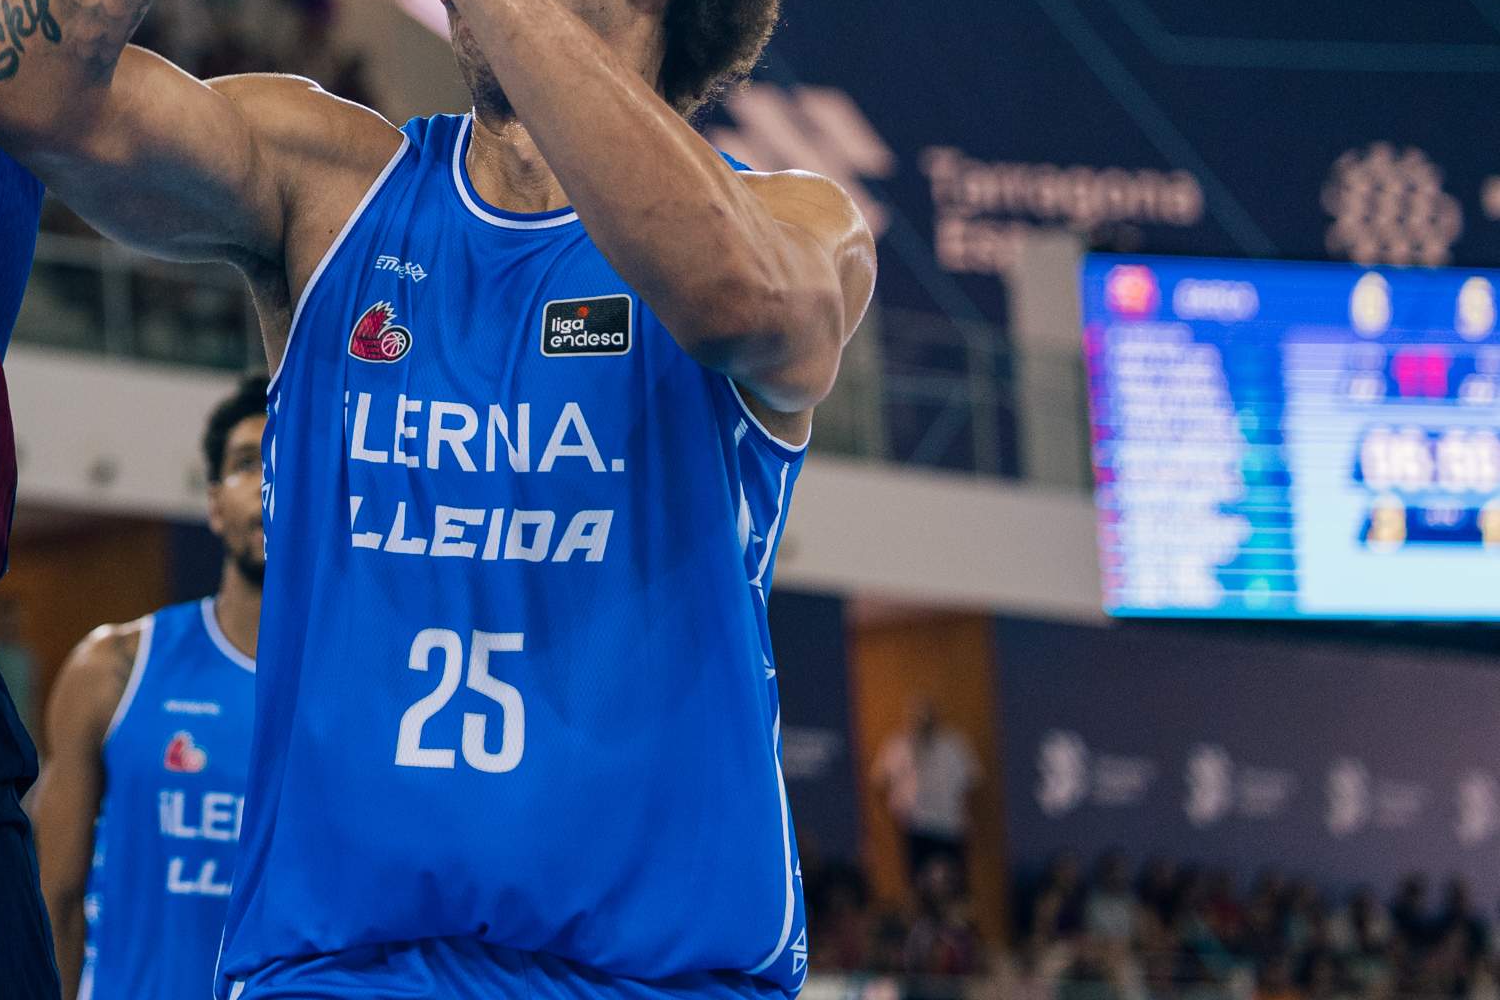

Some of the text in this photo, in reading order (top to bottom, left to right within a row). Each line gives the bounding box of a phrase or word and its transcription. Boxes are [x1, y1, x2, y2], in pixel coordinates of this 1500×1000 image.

[550, 330, 624, 348] endesa
[551, 317, 584, 334] liga
[350, 496, 615, 562] LLEIDA
[395, 627, 526, 774] 25
